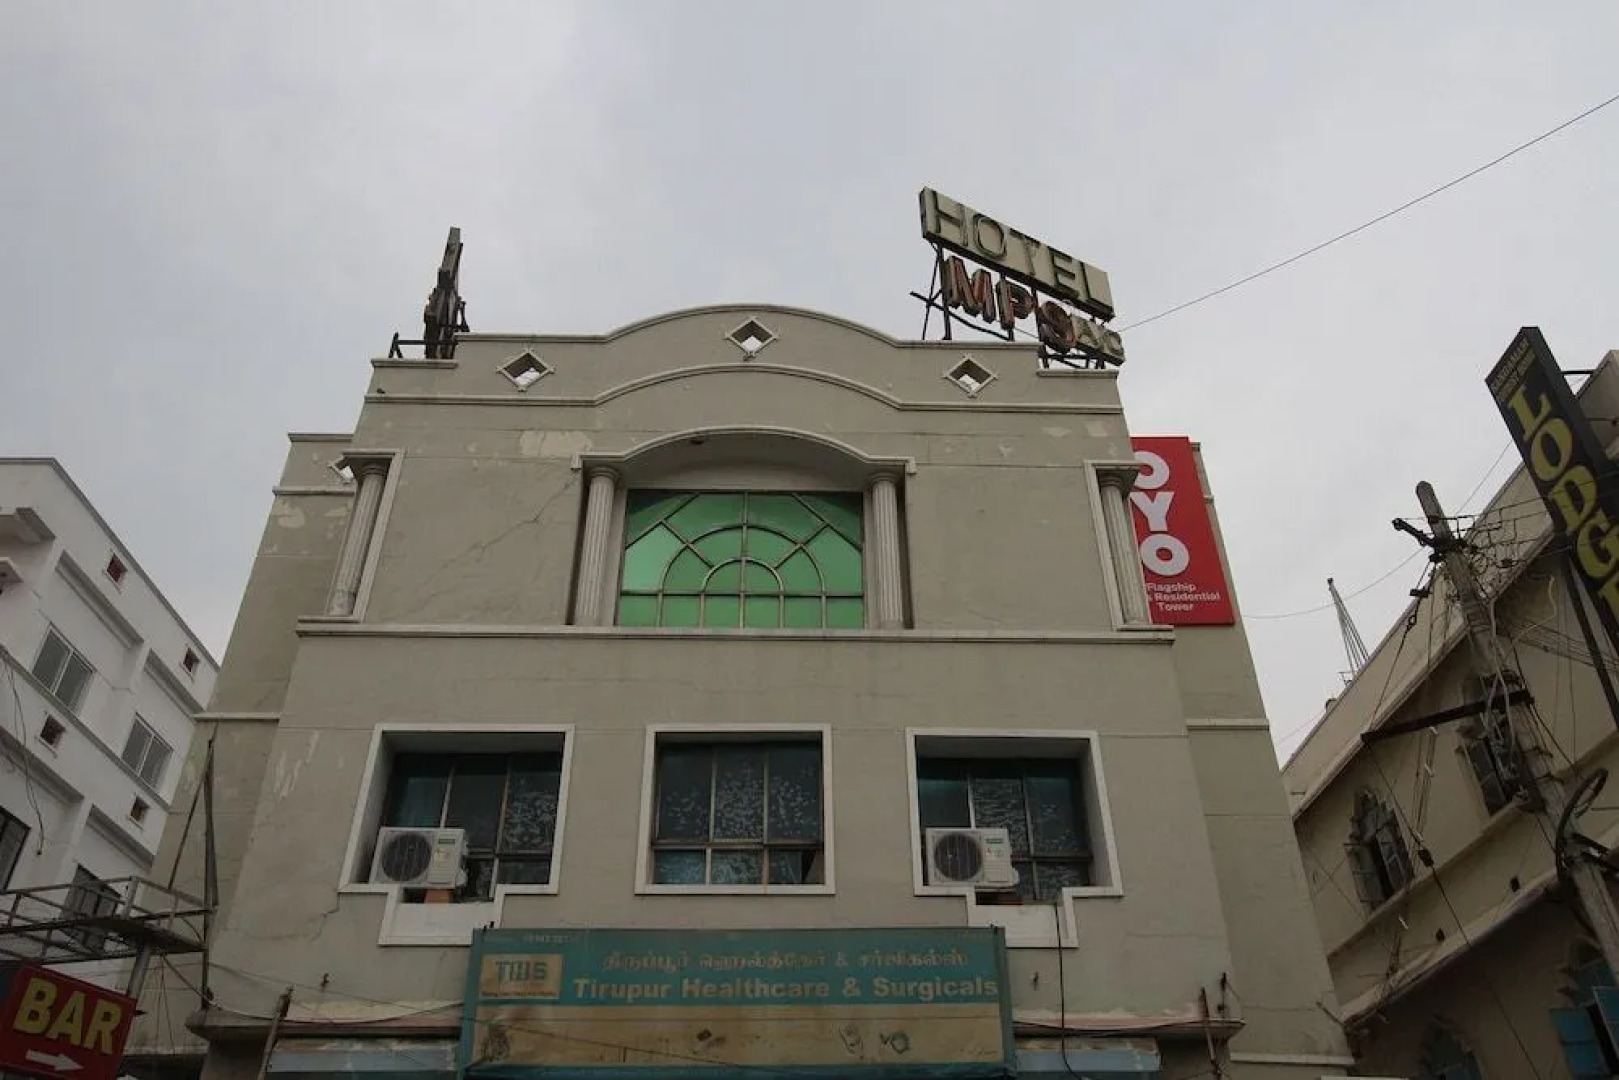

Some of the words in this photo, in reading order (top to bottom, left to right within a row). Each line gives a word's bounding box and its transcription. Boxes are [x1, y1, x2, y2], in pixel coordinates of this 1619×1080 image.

[924, 187, 1114, 314] HOTEL
[1130, 451, 1191, 577] OYO
[1145, 582, 1197, 593] Flagship
[1154, 592, 1220, 602] Residential
[1157, 602, 1194, 612] Tower
[572, 976, 672, 1003] Tirupur
[682, 977, 829, 998] Healthcare
[841, 978, 861, 998] &
[873, 976, 998, 1002] Surgicals
[12, 977, 123, 1055] BAR
